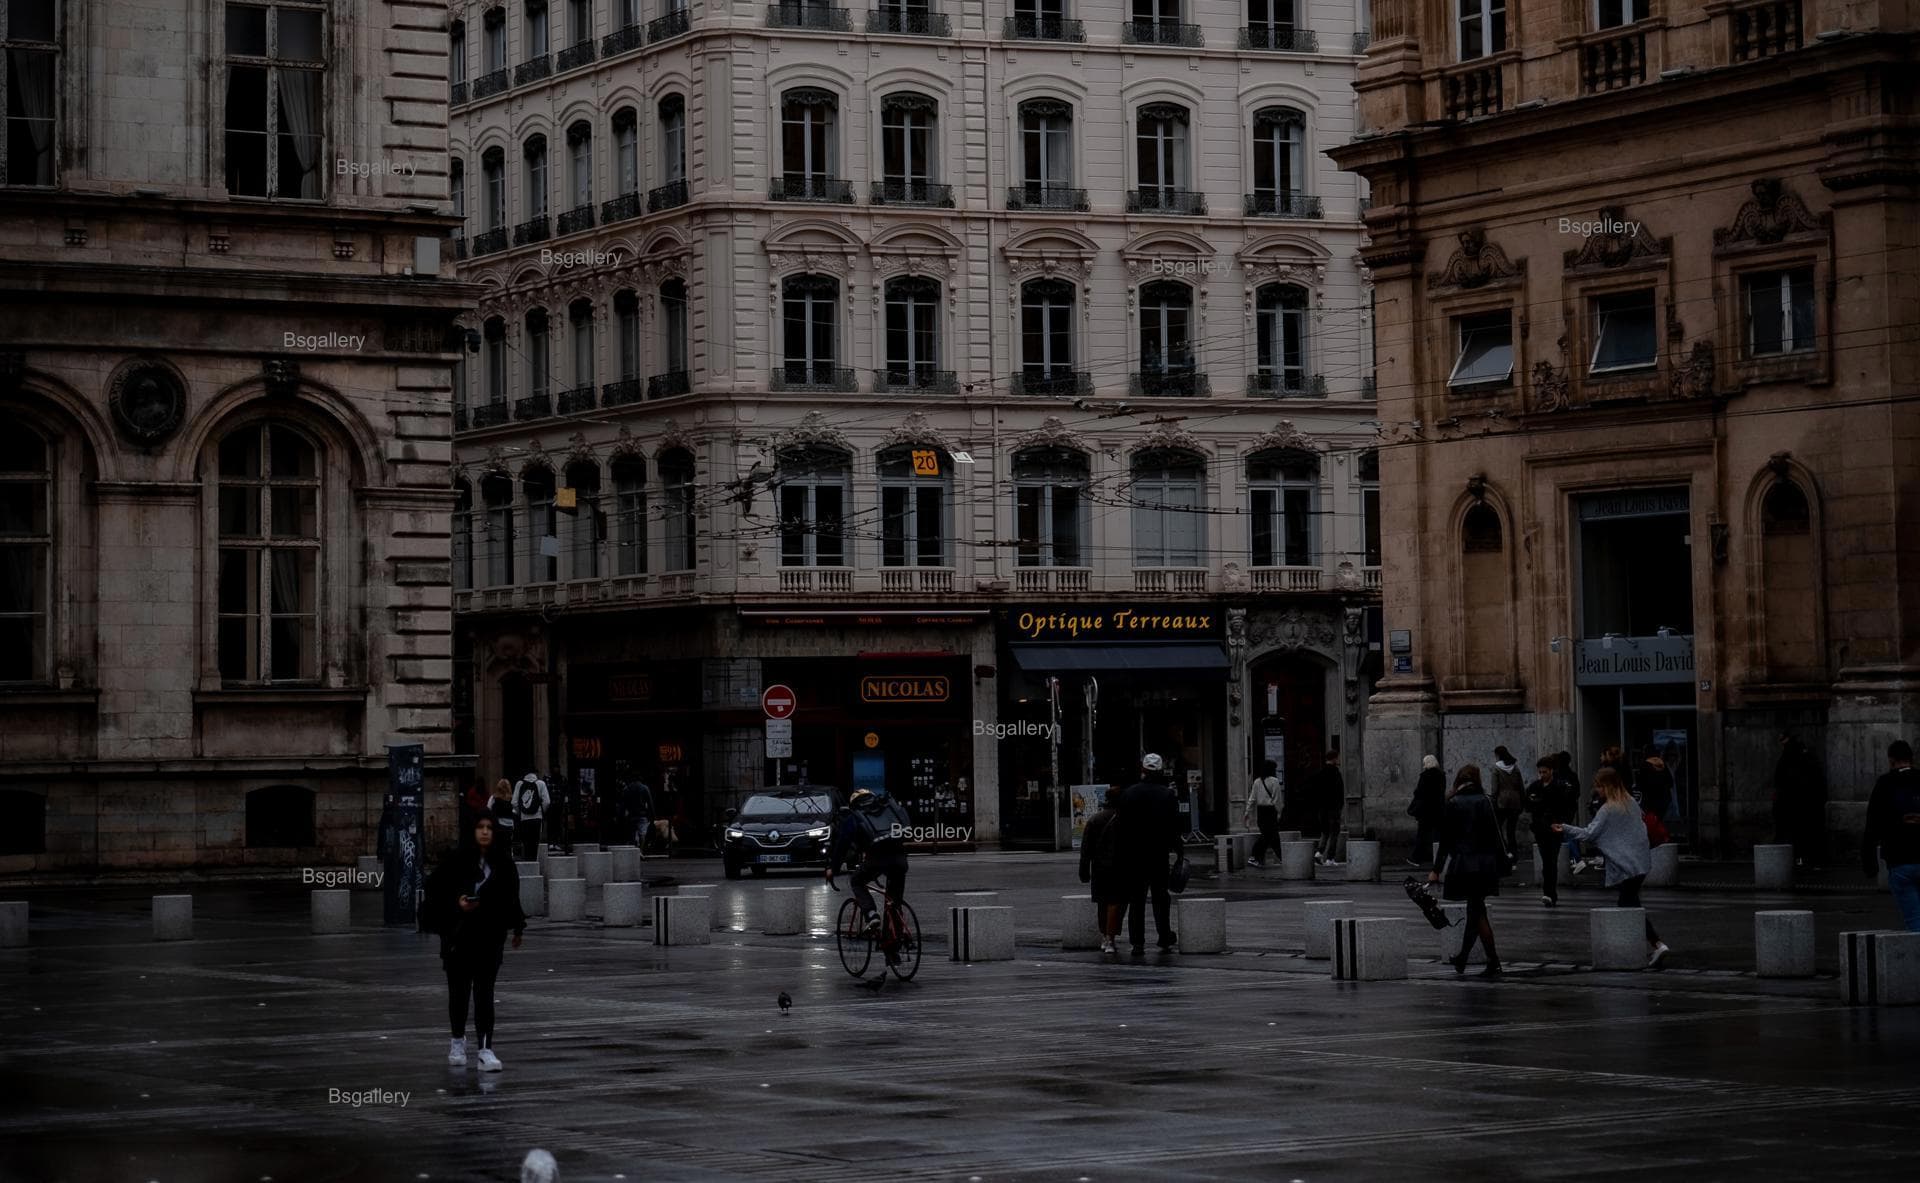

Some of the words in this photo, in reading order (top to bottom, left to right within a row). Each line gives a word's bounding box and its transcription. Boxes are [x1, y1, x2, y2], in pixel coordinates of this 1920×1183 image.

[916, 455, 936, 470] 20
[1018, 611, 1103, 638] Optique
[1113, 608, 1211, 630] Terreaux
[1578, 654, 1609, 674] Jean
[1614, 653, 1651, 673] Louis
[1655, 650, 1694, 672] David
[867, 681, 945, 697] NICOLAS
